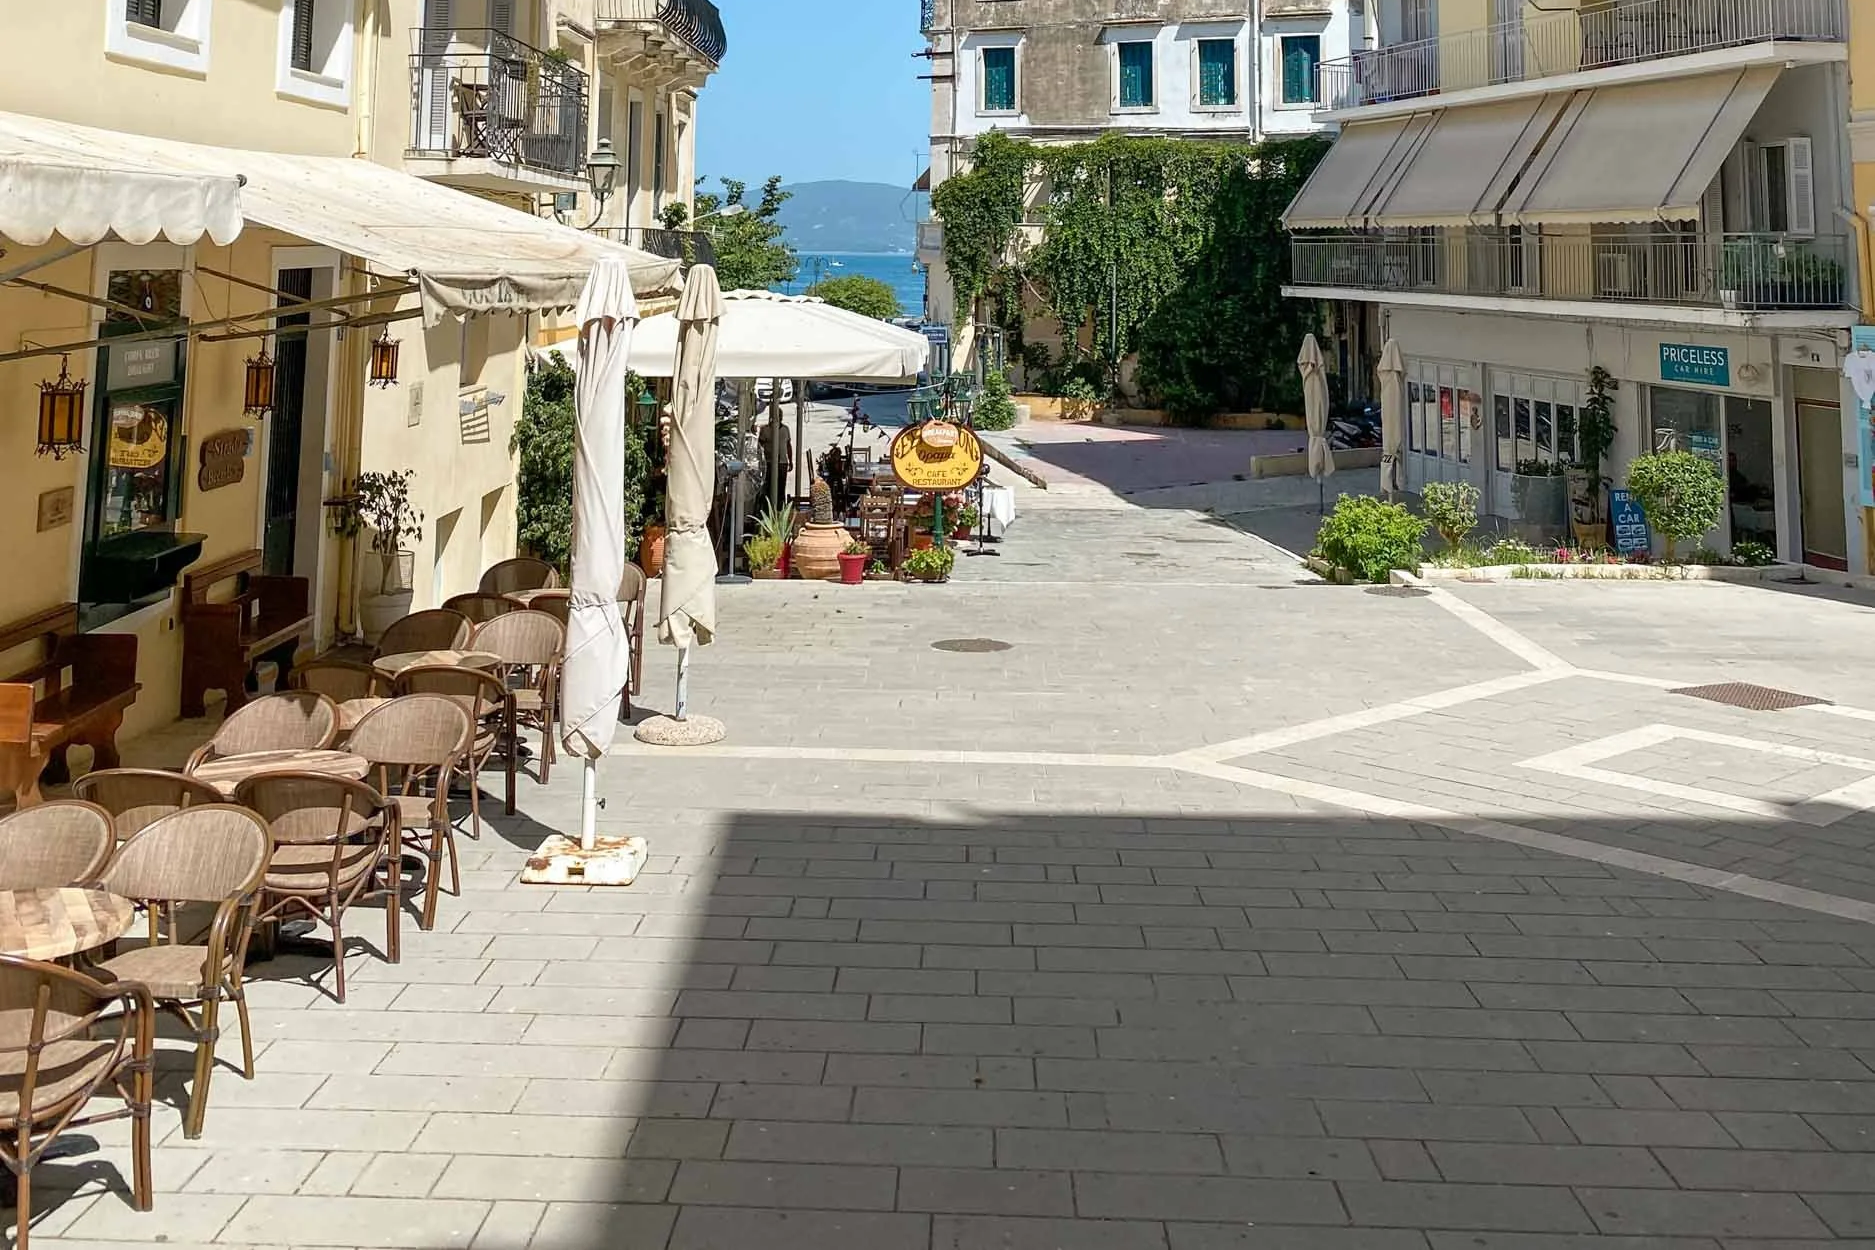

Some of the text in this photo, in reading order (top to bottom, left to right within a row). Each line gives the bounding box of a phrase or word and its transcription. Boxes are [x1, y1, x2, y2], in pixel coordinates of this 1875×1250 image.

[1663, 347, 1725, 366] PRICELESS
[1674, 364, 1715, 376] CAR HIRE
[926, 470, 948, 478] CAFE
[912, 478, 962, 486] RESTAURANT
[1614, 492, 1637, 502] RE
[1624, 503, 1632, 512] A
[1618, 513, 1640, 523] CAR
